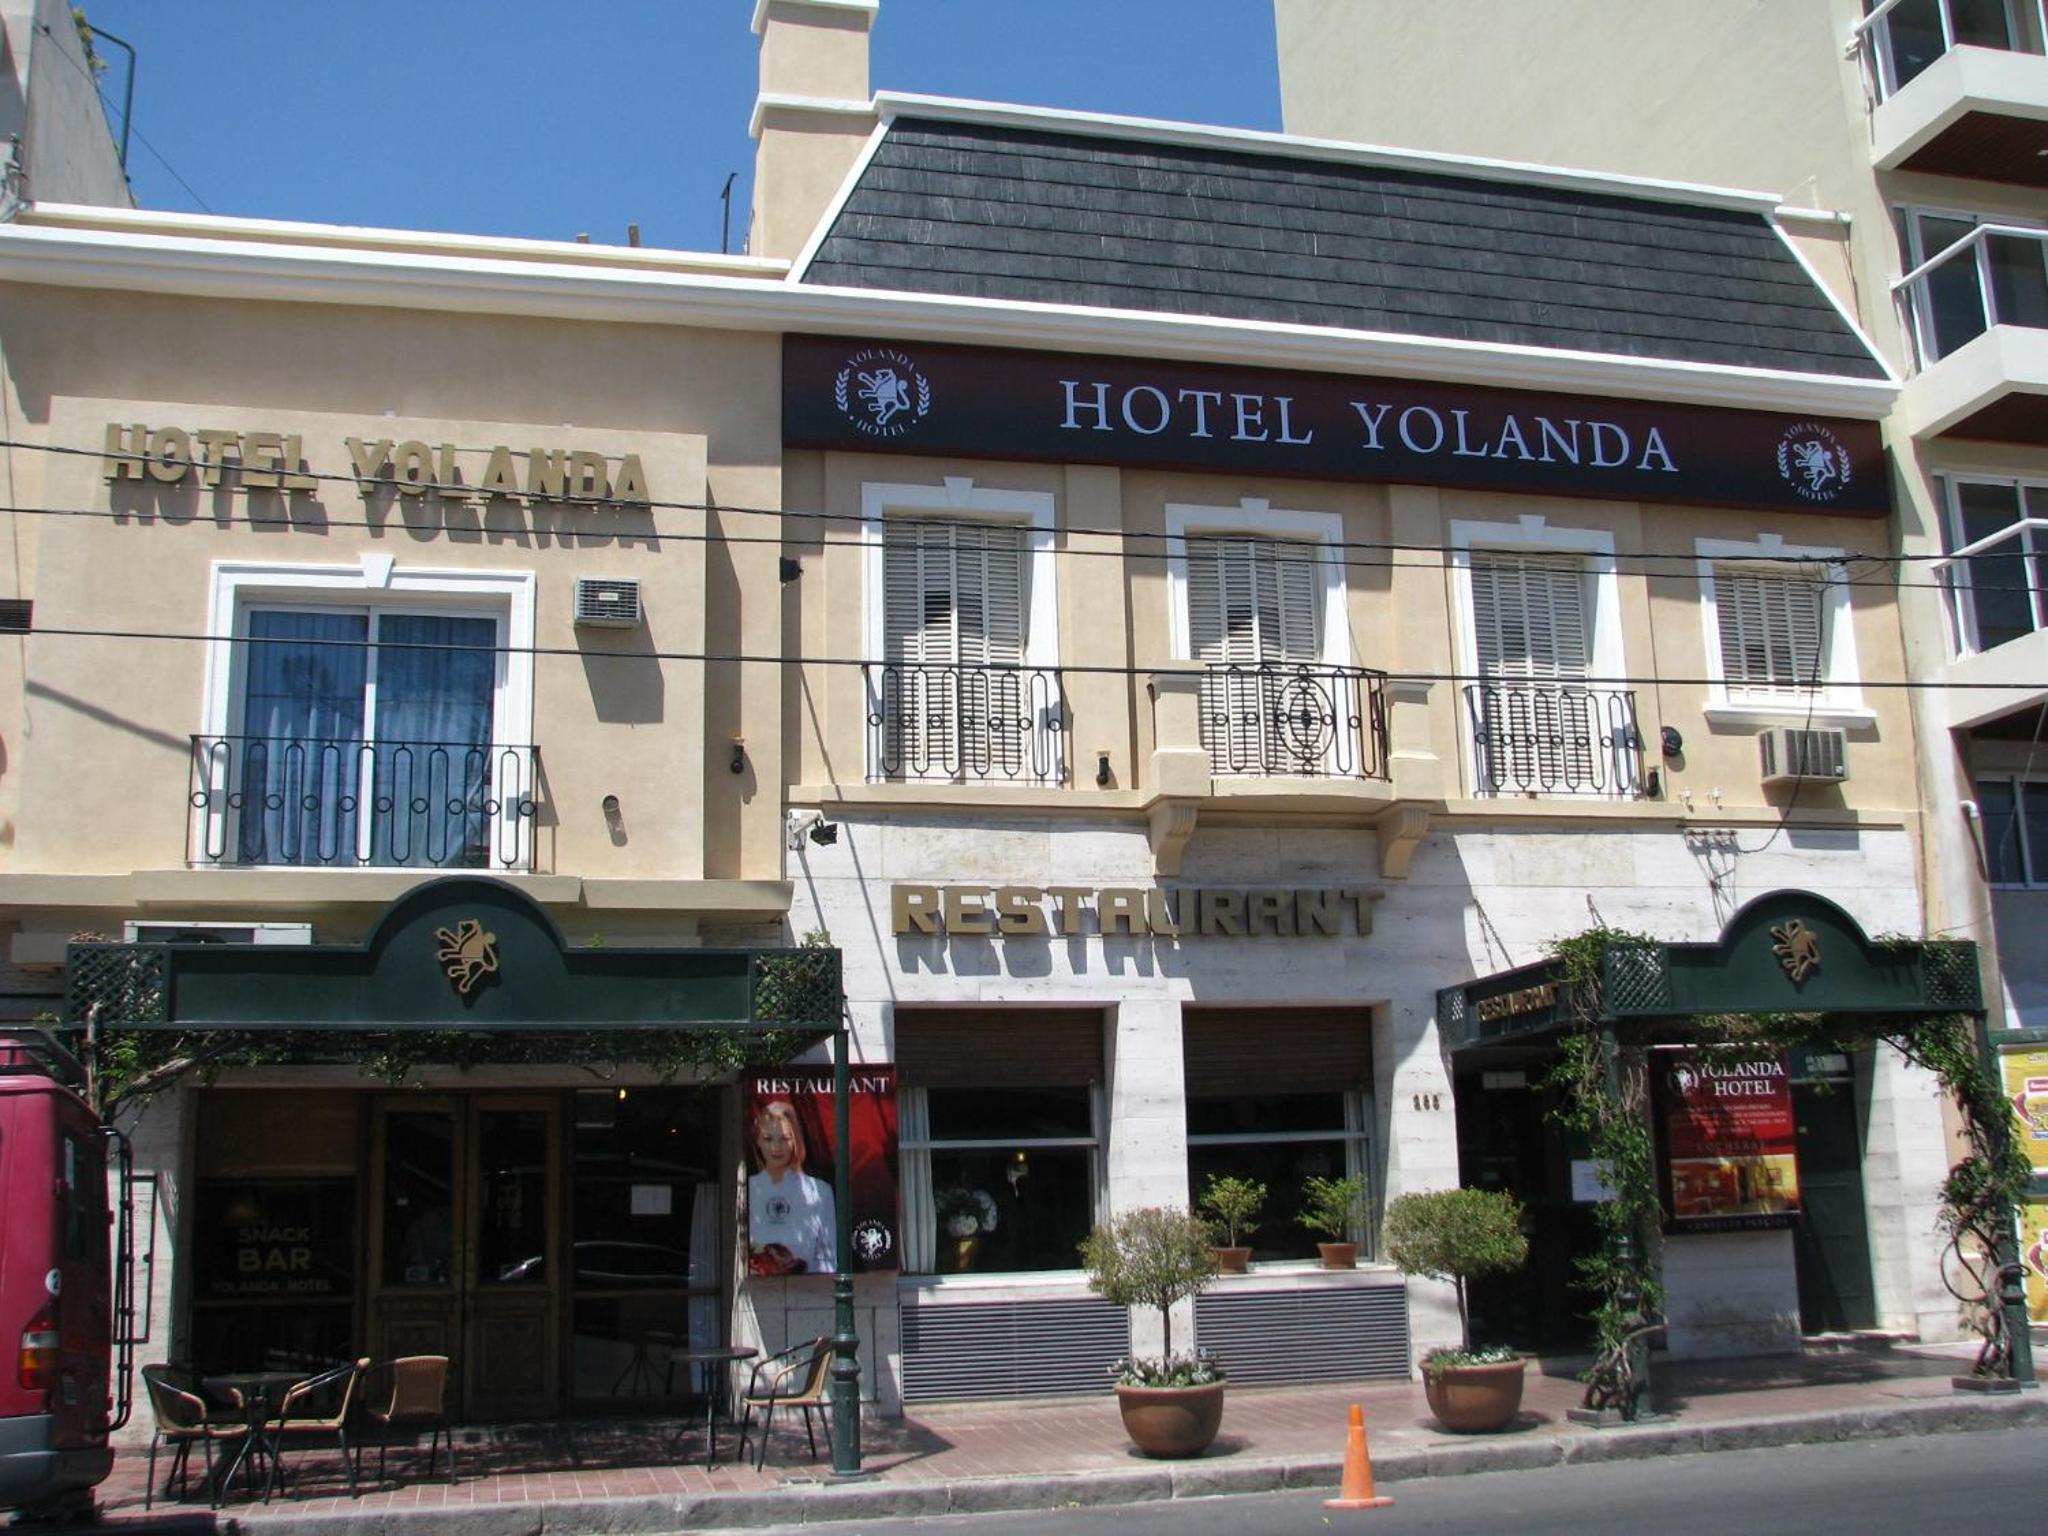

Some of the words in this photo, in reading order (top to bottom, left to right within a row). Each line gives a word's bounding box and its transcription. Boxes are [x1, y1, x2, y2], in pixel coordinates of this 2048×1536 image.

[1059, 380, 1313, 446] HOTEL
[1349, 401, 1680, 473] YOLANDA
[105, 423, 318, 490] HOTEL
[346, 437, 651, 506] YOLANDA
[891, 884, 1386, 937] RESTAURANT
[1696, 1061, 1785, 1078] YOLANDA
[757, 1077, 889, 1094] RESTAUANT
[1714, 1080, 1776, 1096] HOTEL
[238, 1227, 311, 1242] SNACK
[238, 1247, 311, 1271] BAR
